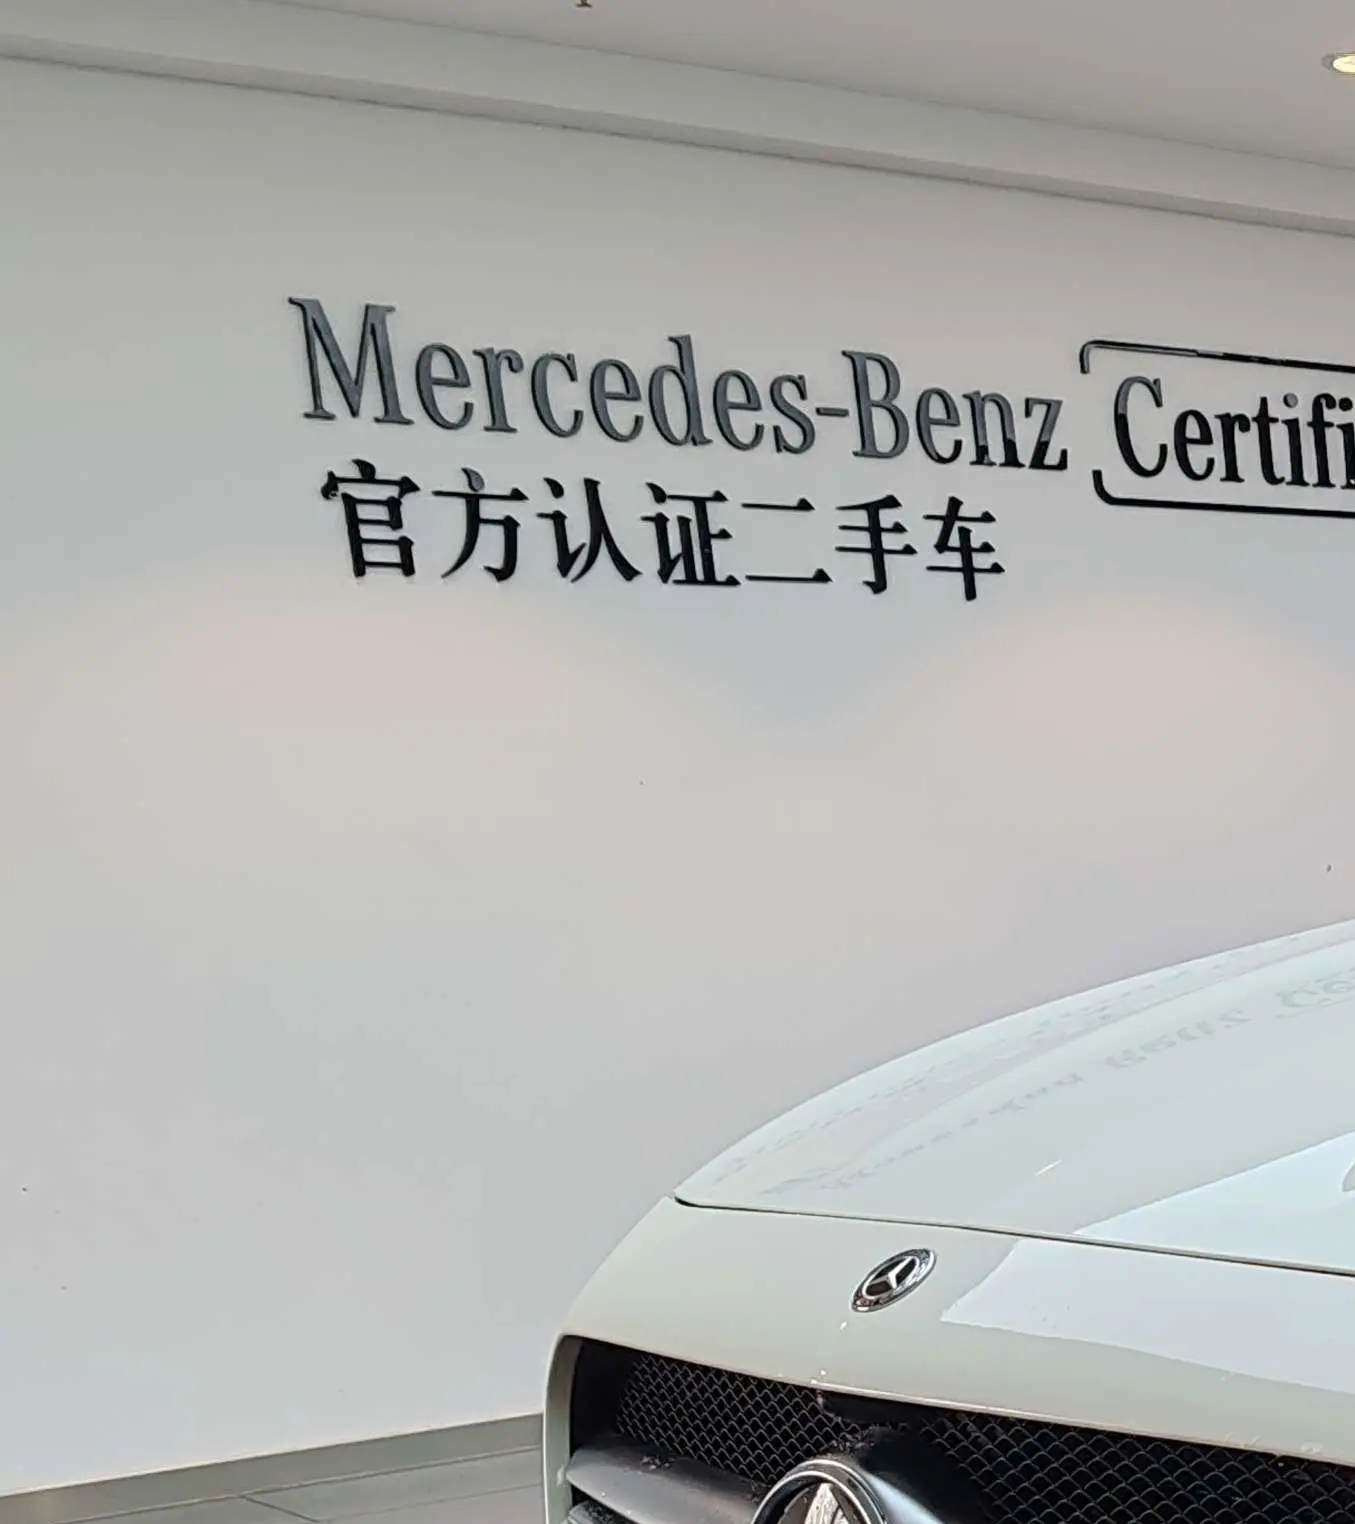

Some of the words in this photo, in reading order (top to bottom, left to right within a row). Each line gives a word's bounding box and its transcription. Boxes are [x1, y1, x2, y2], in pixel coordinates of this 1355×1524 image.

[288, 296, 1069, 471] Mercedes-Benz
[321, 459, 1005, 602] 官方认证二手车
